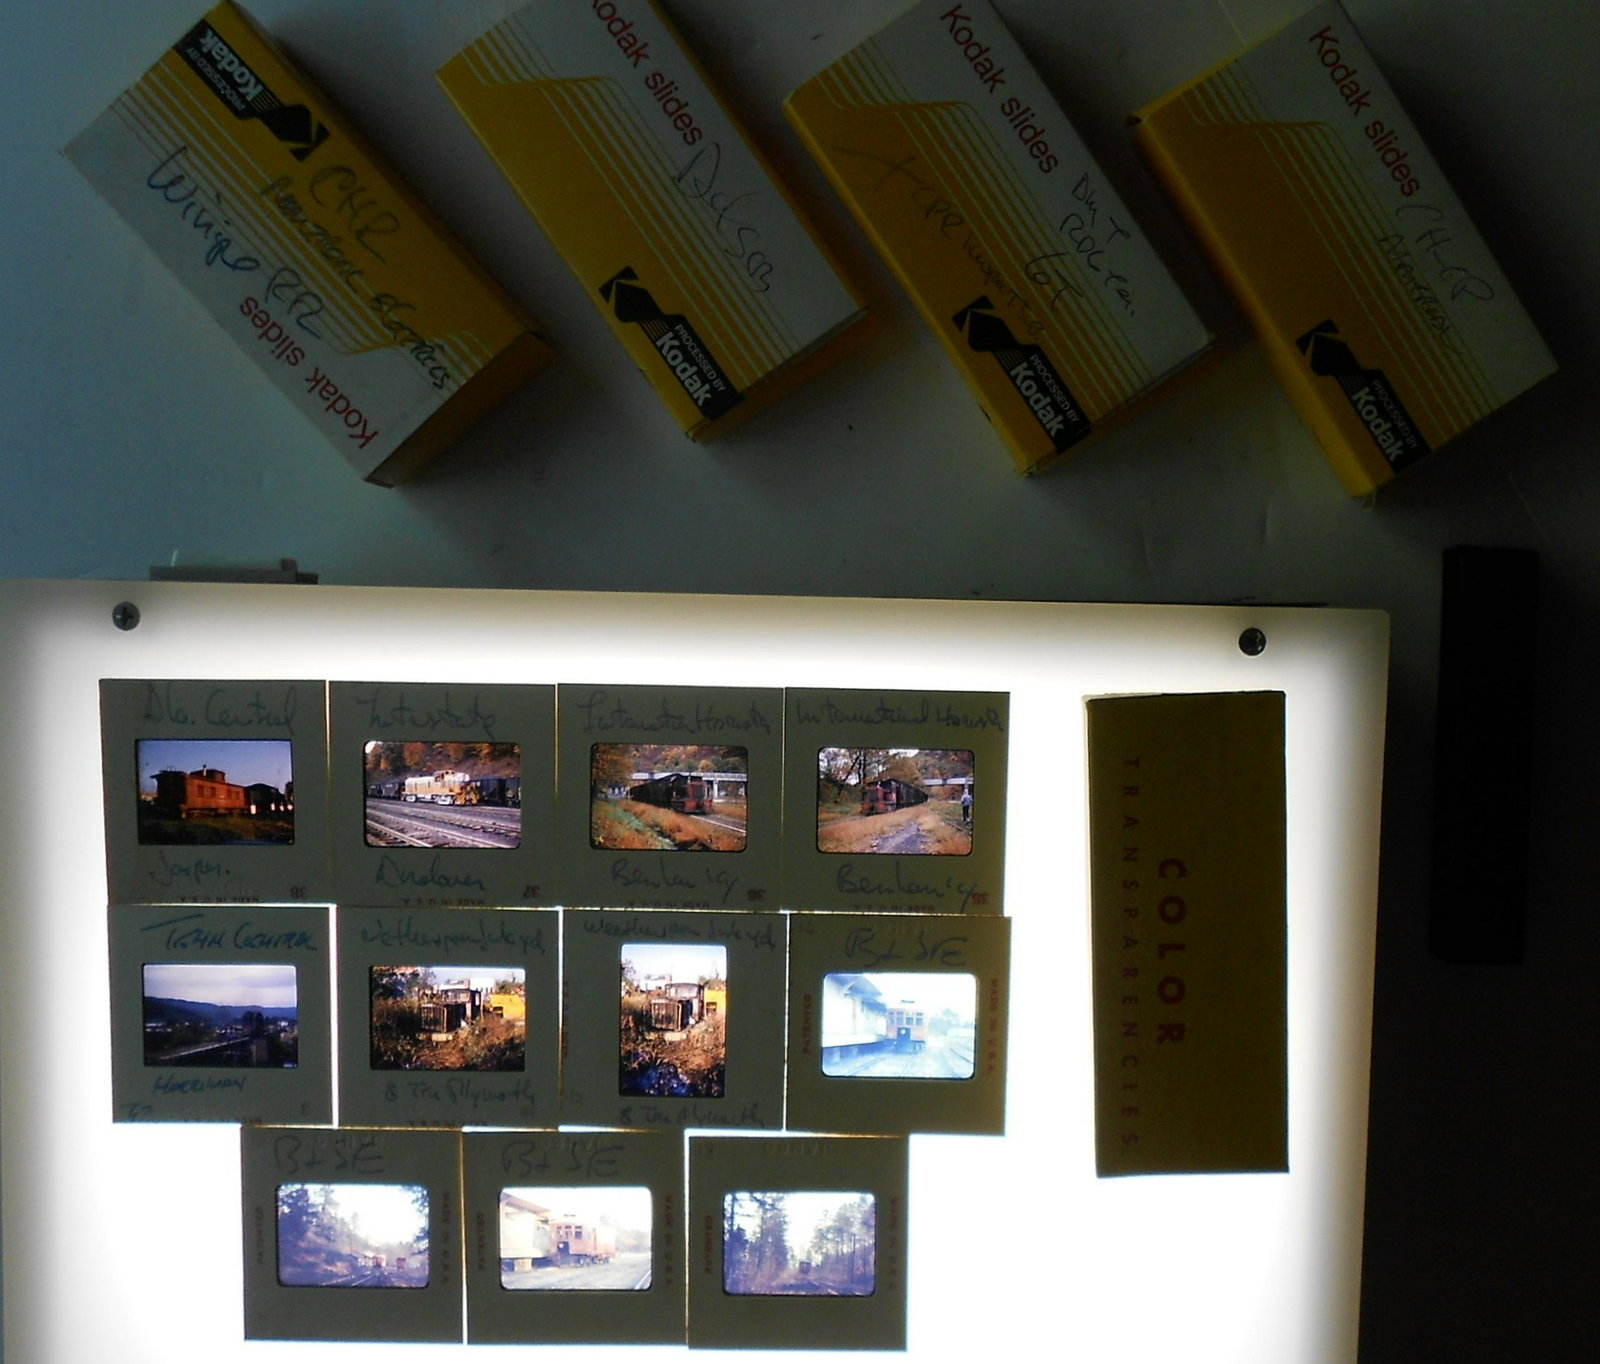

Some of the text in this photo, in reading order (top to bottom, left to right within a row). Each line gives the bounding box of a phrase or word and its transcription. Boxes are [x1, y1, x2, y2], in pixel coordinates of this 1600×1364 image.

[200, 28, 265, 101] Kodak
[592, 0, 704, 147] odak slides
[940, 4, 1059, 175] Kodak slides
[1307, 25, 1421, 199] Kodak slides
[238, 296, 379, 450] Kodak slides
[654, 331, 712, 408] Kodak
[674, 323, 728, 392] PROCESSED BY
[1029, 353, 1070, 411] PROCESSED
[1065, 407, 1081, 423] BY
[1009, 360, 1064, 438] Kodak
[1351, 387, 1405, 463] Kodak
[206, 685, 297, 736] Central
[1121, 755, 1142, 1147] TRANSPARENCIES
[1156, 856, 1188, 1046] COLOR
[802, 993, 814, 1055] PATENTED
[988, 977, 1000, 1012] MADE
[475, 1210, 486, 1272] PATENTED
[704, 1214, 715, 1274] PATENTED
